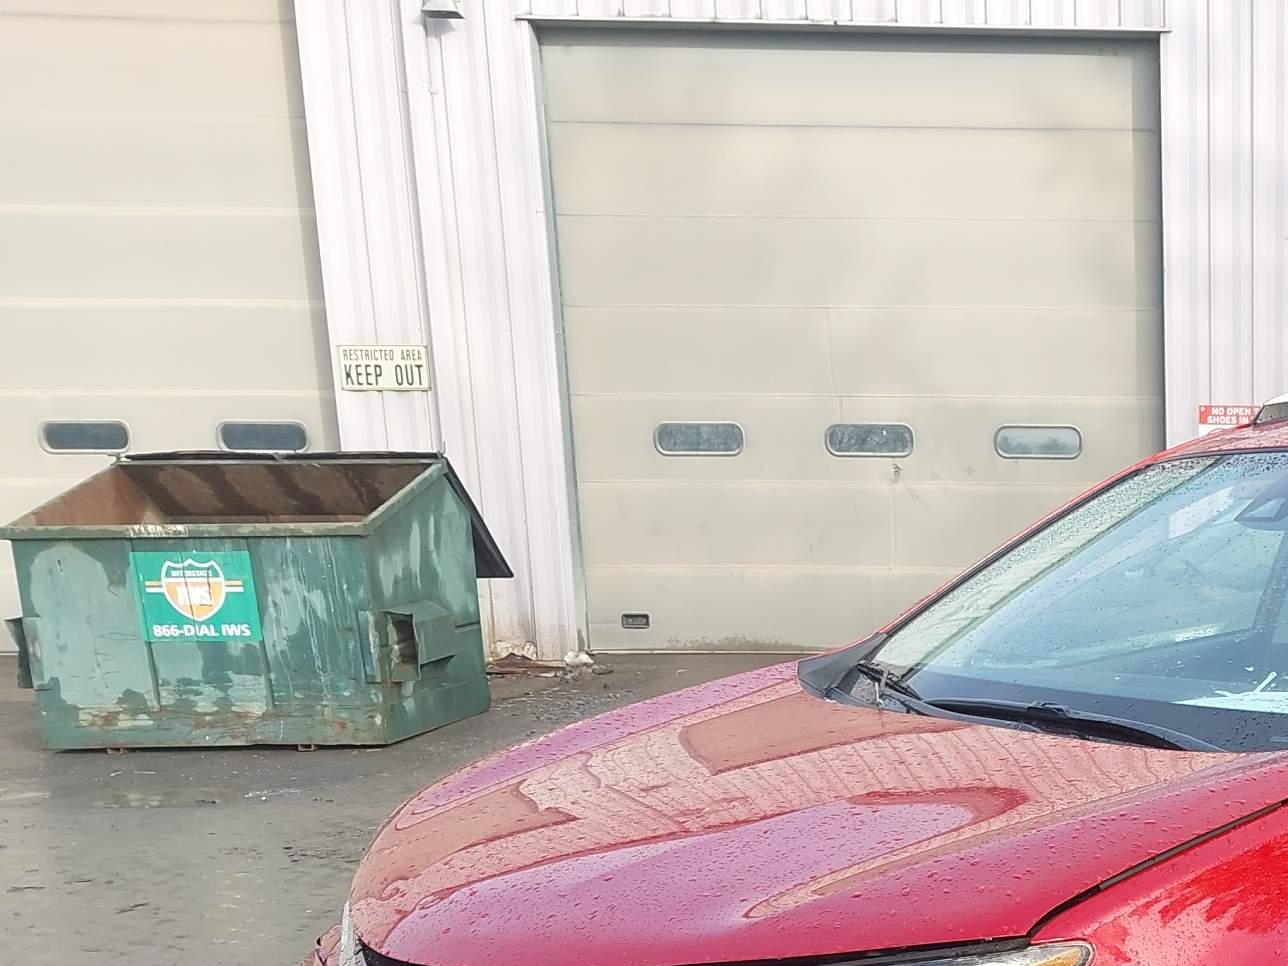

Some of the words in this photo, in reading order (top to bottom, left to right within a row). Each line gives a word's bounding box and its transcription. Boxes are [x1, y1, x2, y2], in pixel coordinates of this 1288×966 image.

[342, 349, 394, 361] RESTRICTED
[400, 349, 422, 361] AREA
[344, 364, 383, 386] KEEP
[394, 364, 424, 386] OUT
[1211, 407, 1225, 416] NO
[1226, 407, 1252, 416] OPEN
[1207, 415, 1237, 424] SHOES
[1239, 416, 1249, 424] IN
[152, 624, 219, 637] 866-DIAL
[221, 623, 252, 637] IWS
